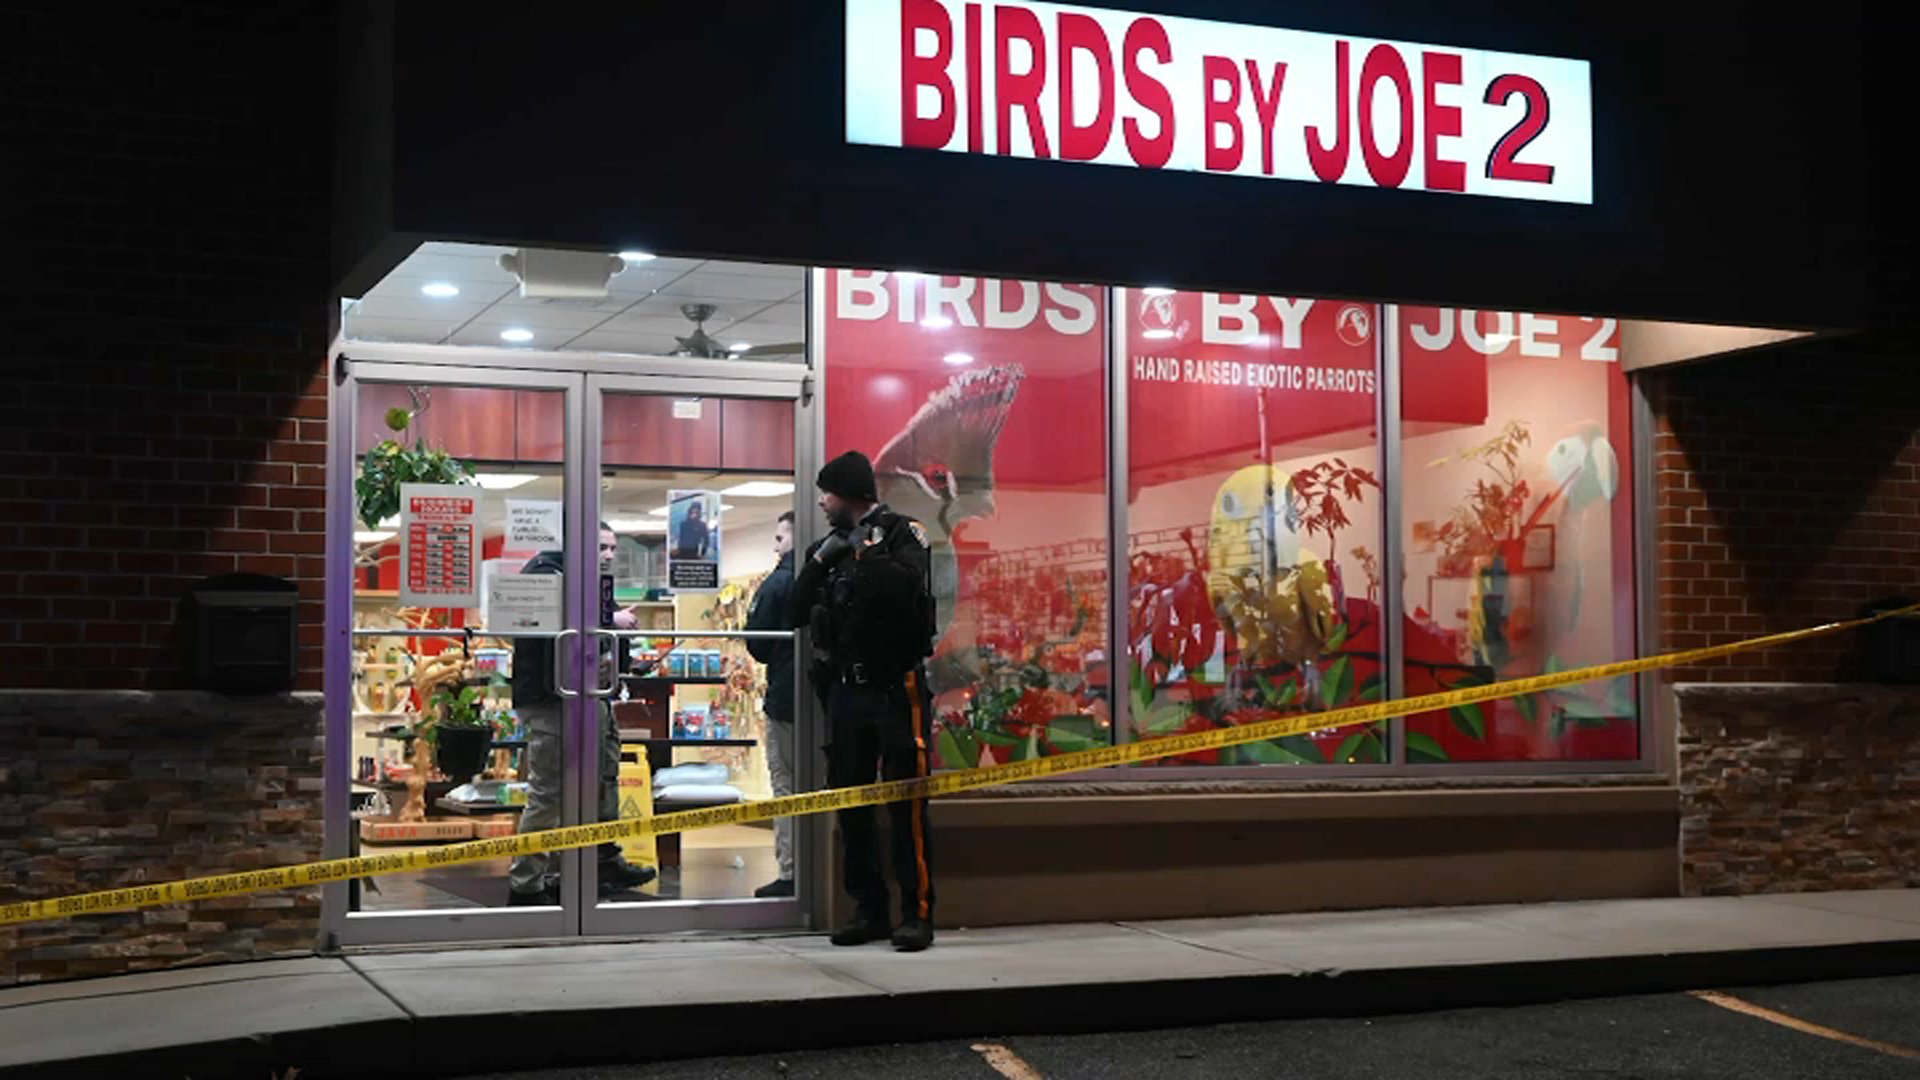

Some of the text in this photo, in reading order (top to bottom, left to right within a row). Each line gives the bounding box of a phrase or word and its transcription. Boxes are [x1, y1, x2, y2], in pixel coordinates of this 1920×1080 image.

[900, 0, 1555, 192] BIRDS BY JOE 2
[836, 268, 1618, 362] BIRDS BY JOE 2
[1133, 356, 1376, 394] HAND RAISED EXOTIC PARROTS
